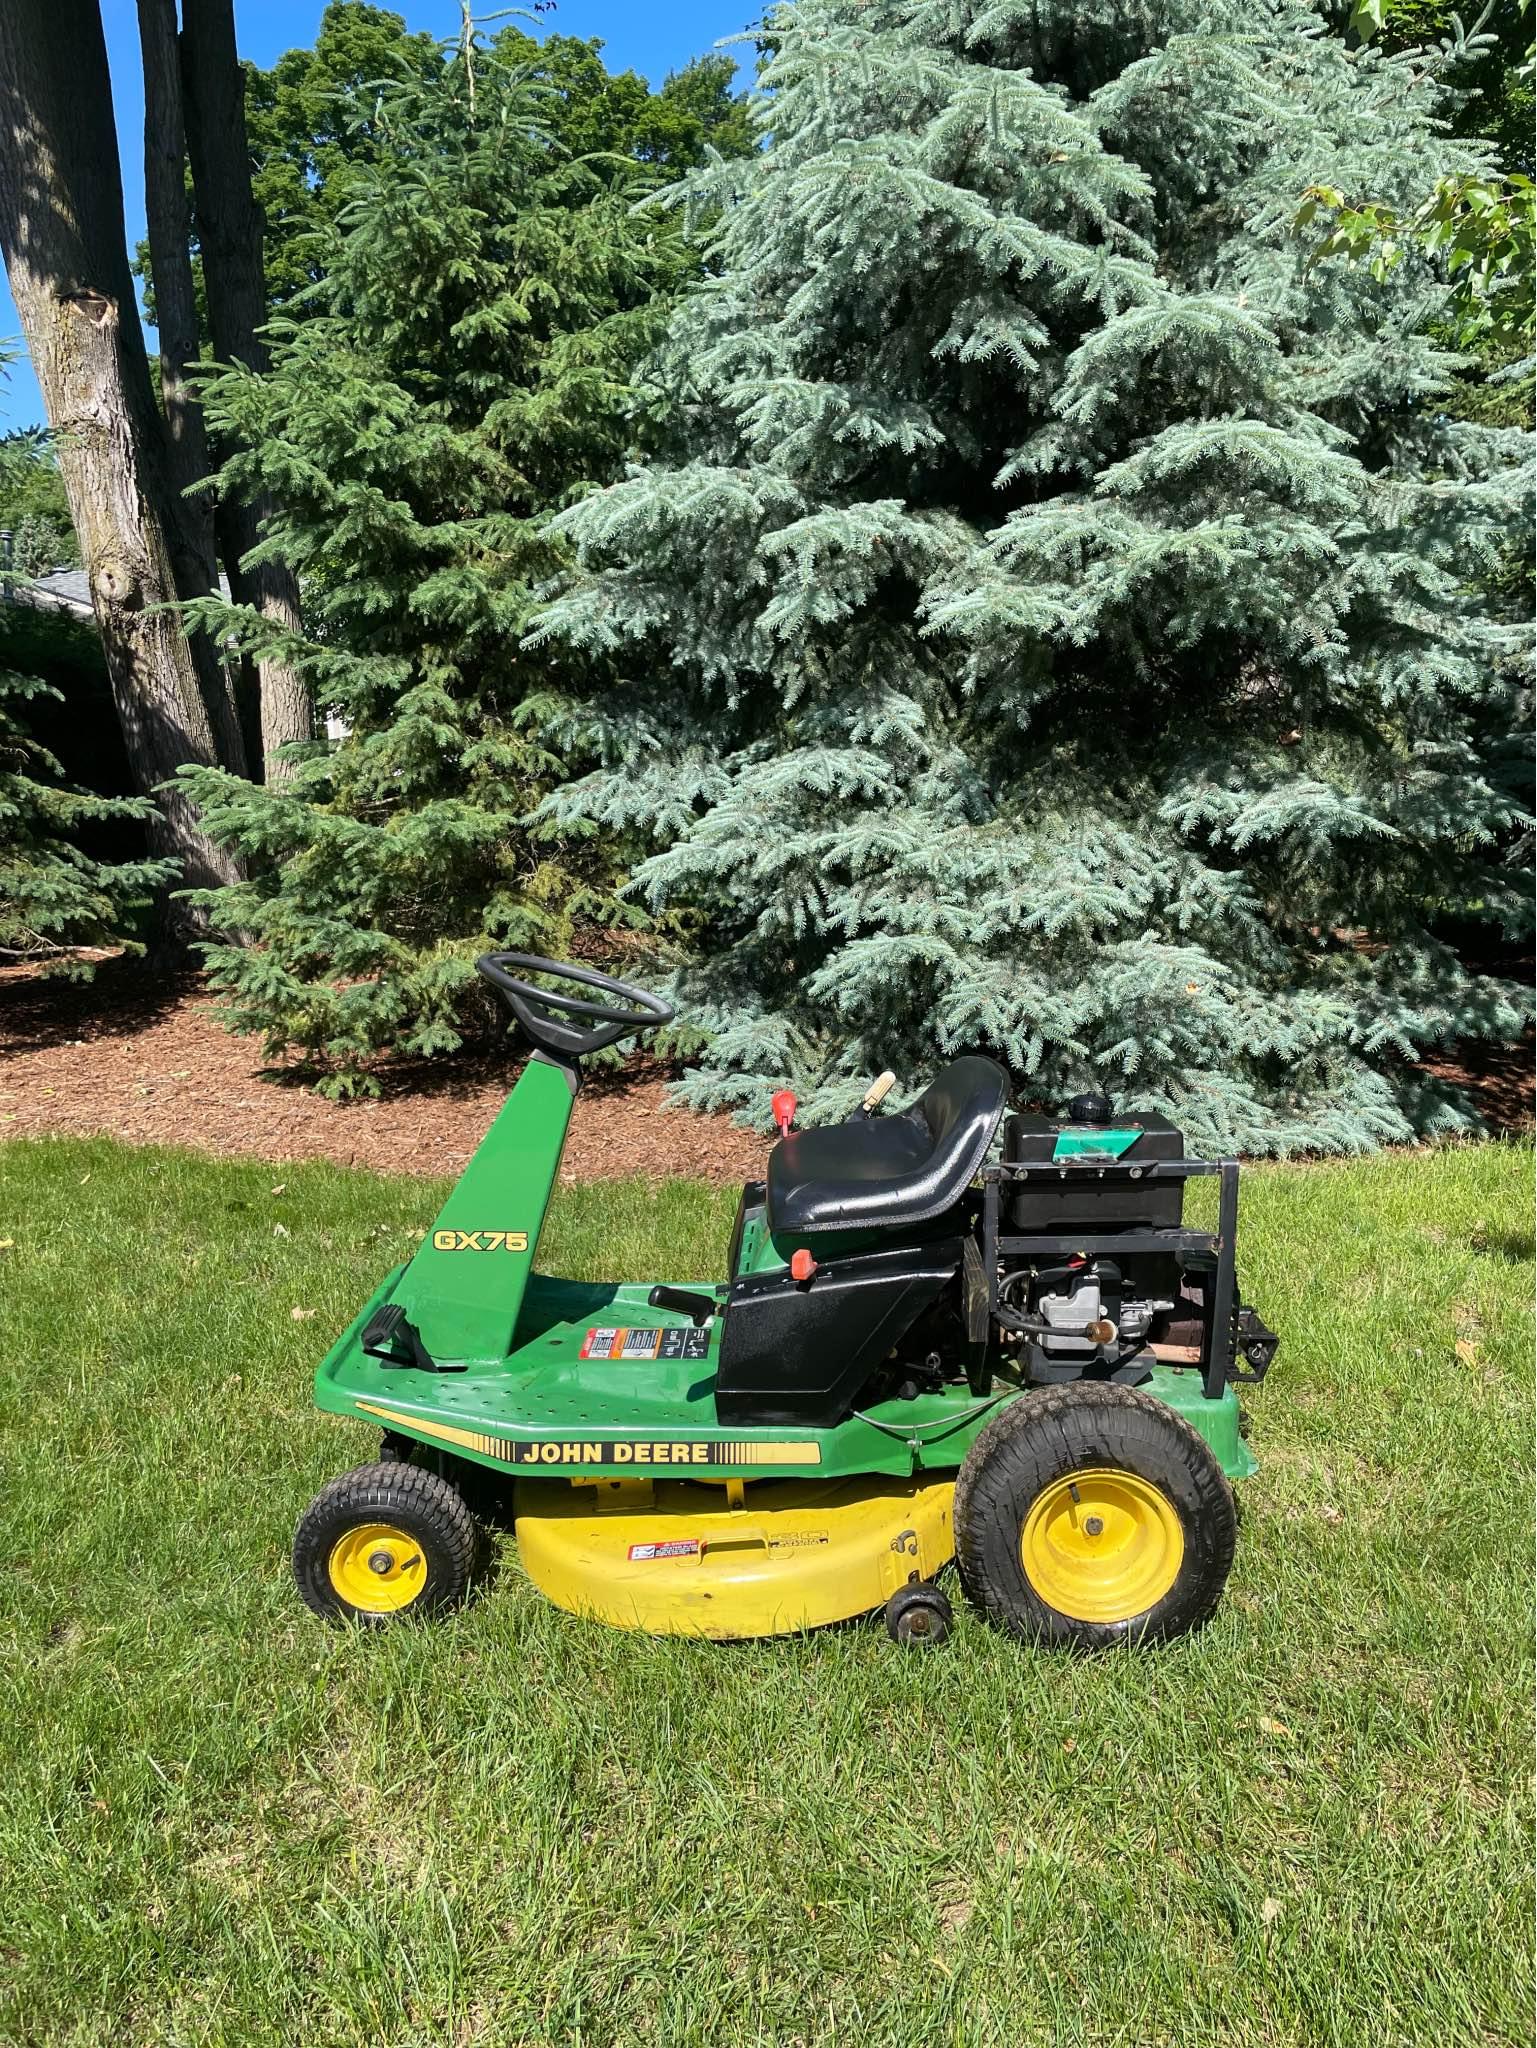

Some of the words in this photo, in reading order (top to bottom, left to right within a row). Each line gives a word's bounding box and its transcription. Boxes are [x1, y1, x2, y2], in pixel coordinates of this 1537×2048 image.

[433, 1229, 528, 1252] GX75
[523, 1443, 602, 1463] JOHN
[613, 1443, 709, 1463] DEERE
